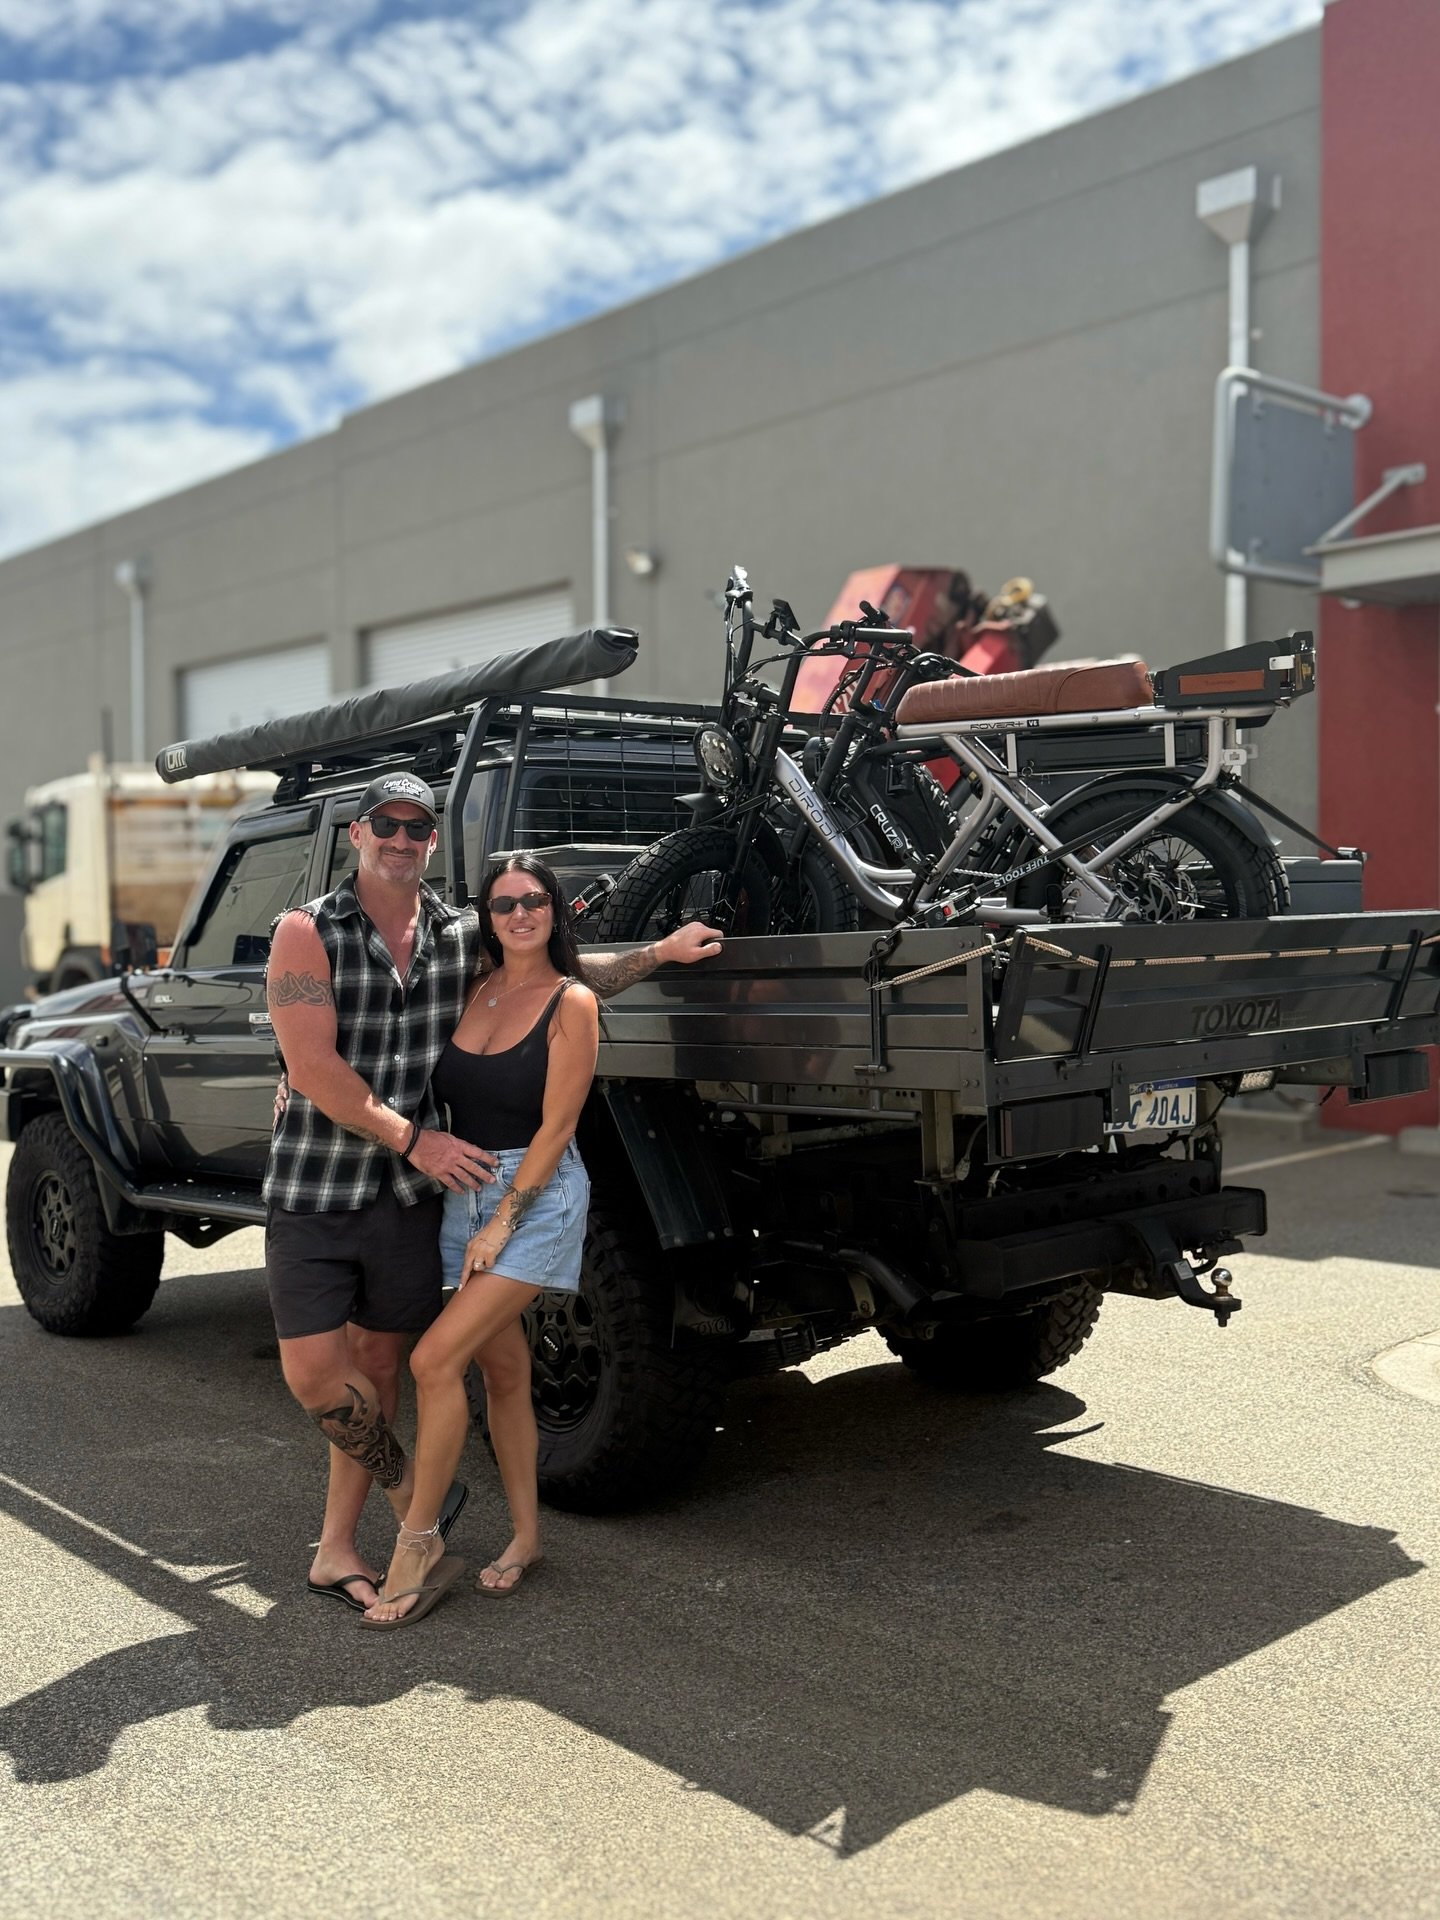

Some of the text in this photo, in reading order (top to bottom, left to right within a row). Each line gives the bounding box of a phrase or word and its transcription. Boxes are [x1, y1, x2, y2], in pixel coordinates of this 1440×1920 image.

[970, 721, 1024, 730] ROVER+
[788, 778, 836, 841] DIRODI
[870, 804, 903, 852] CRUZR
[994, 855, 1050, 888] TUFF TOOLS
[1190, 999, 1281, 1036] TOYOTA
[1146, 1094, 1193, 1127] 404J
